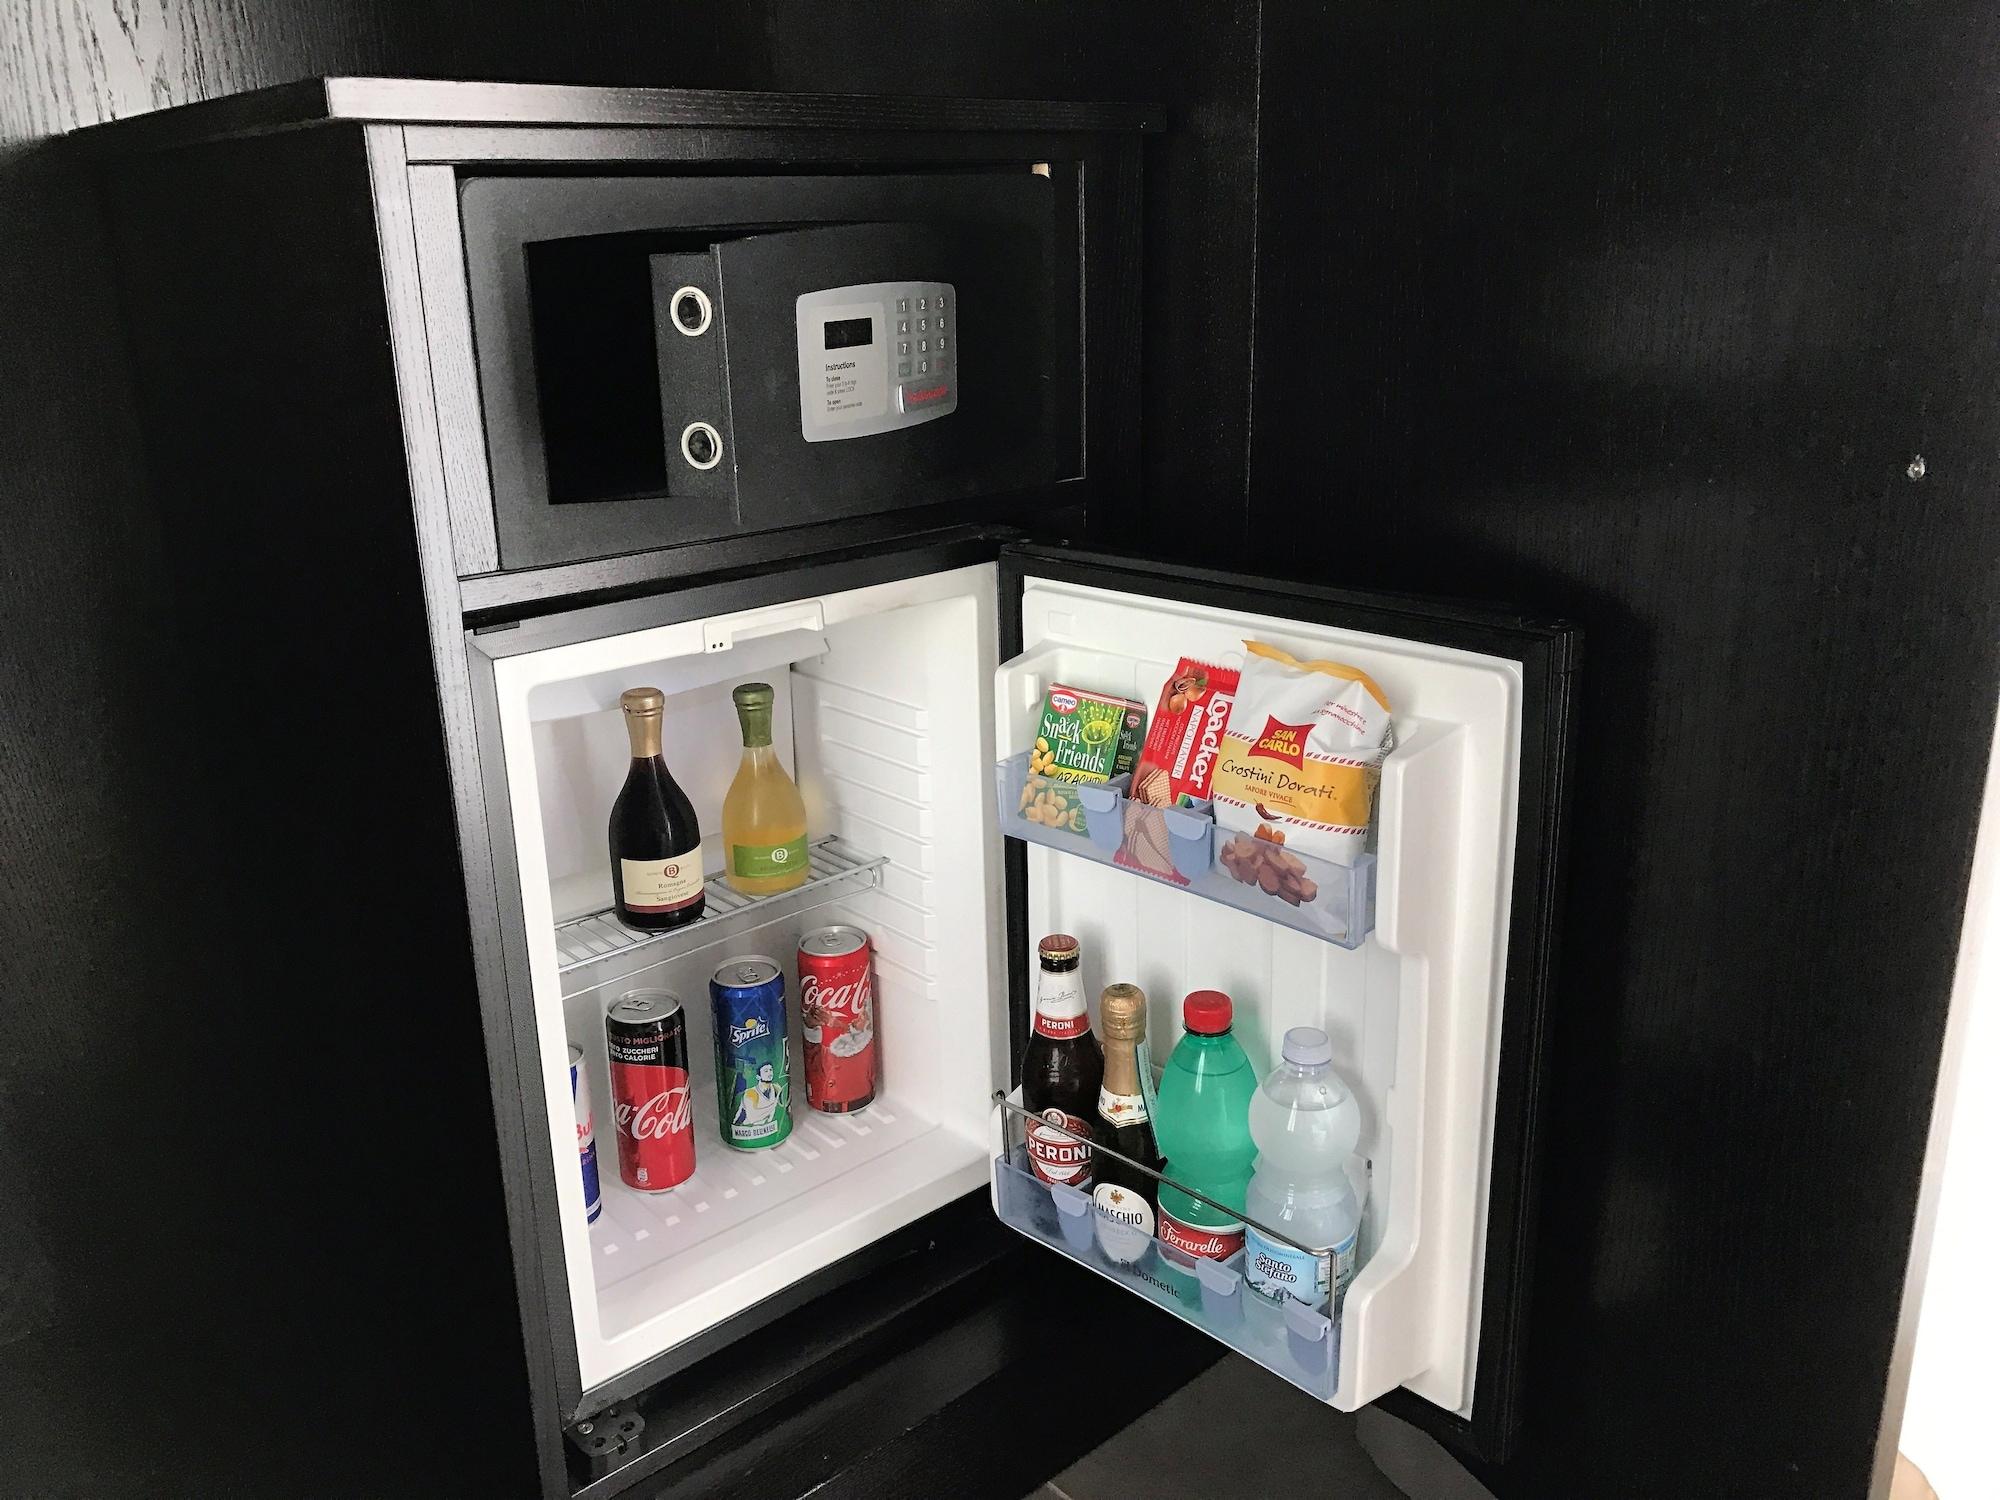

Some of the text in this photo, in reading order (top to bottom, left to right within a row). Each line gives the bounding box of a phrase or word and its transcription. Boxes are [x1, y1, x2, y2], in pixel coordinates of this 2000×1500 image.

[920, 298, 926, 310] 2
[922, 340, 926, 352] 8
[825, 361, 856, 372] Instructions
[1053, 696, 1076, 706] cameo
[1041, 713, 1082, 744] Snack
[1272, 730, 1297, 742] SAN
[1174, 708, 1202, 776] NAPOLITANER
[1190, 691, 1235, 790] Loacker
[1258, 739, 1300, 756] CARLO
[1054, 740, 1106, 773] Friends
[1222, 760, 1274, 784] Crostini
[1244, 784, 1293, 803] SAPORE VIVACE
[732, 1022, 766, 1044] Sprite
[1042, 1018, 1074, 1030] PERONI
[622, 1046, 659, 1054] ZUCCHERI
[1028, 1136, 1092, 1161] PERONI
[1160, 1221, 1224, 1255] Ferrarelle
[1256, 1260, 1297, 1282] Stefano
[1259, 1252, 1291, 1272] Santo
[1133, 1267, 1181, 1298] Dometic
